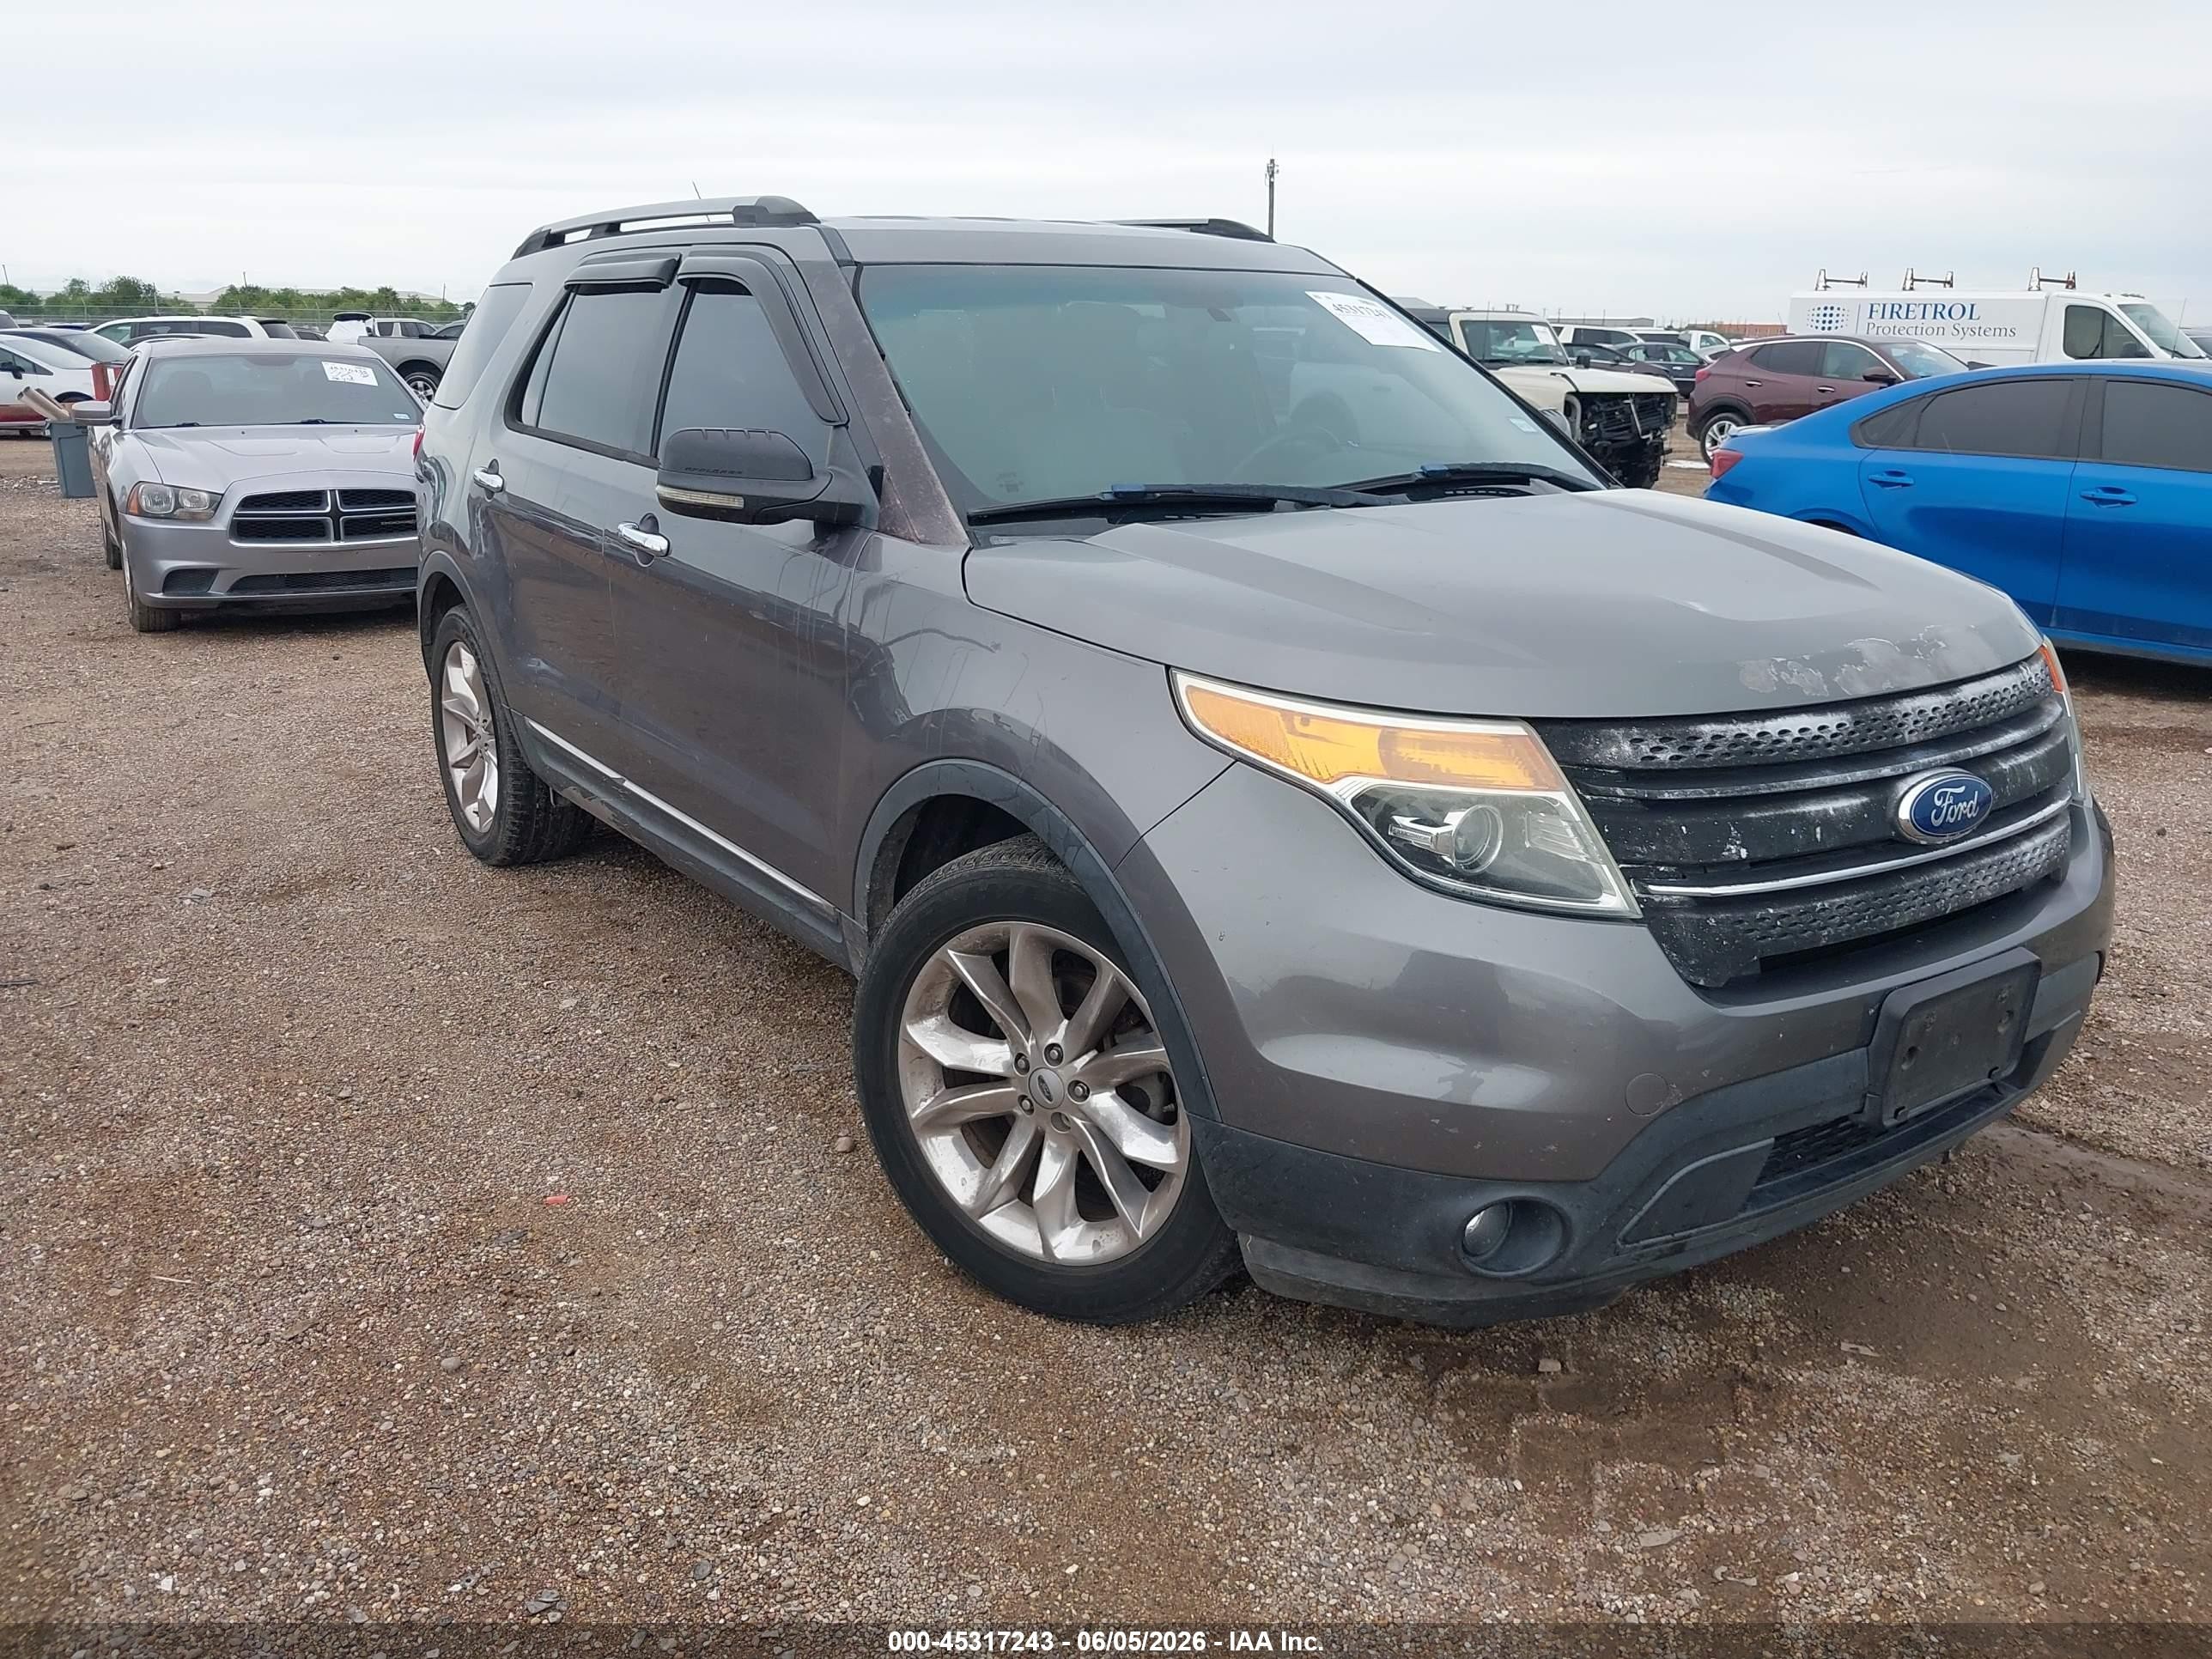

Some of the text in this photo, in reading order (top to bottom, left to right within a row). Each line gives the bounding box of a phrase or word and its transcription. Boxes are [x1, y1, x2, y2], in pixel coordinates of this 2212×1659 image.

[1868, 302, 1980, 319] FIRETROL
[1866, 323, 2017, 340] Protection Systems
[1930, 785, 1979, 827] Ford
